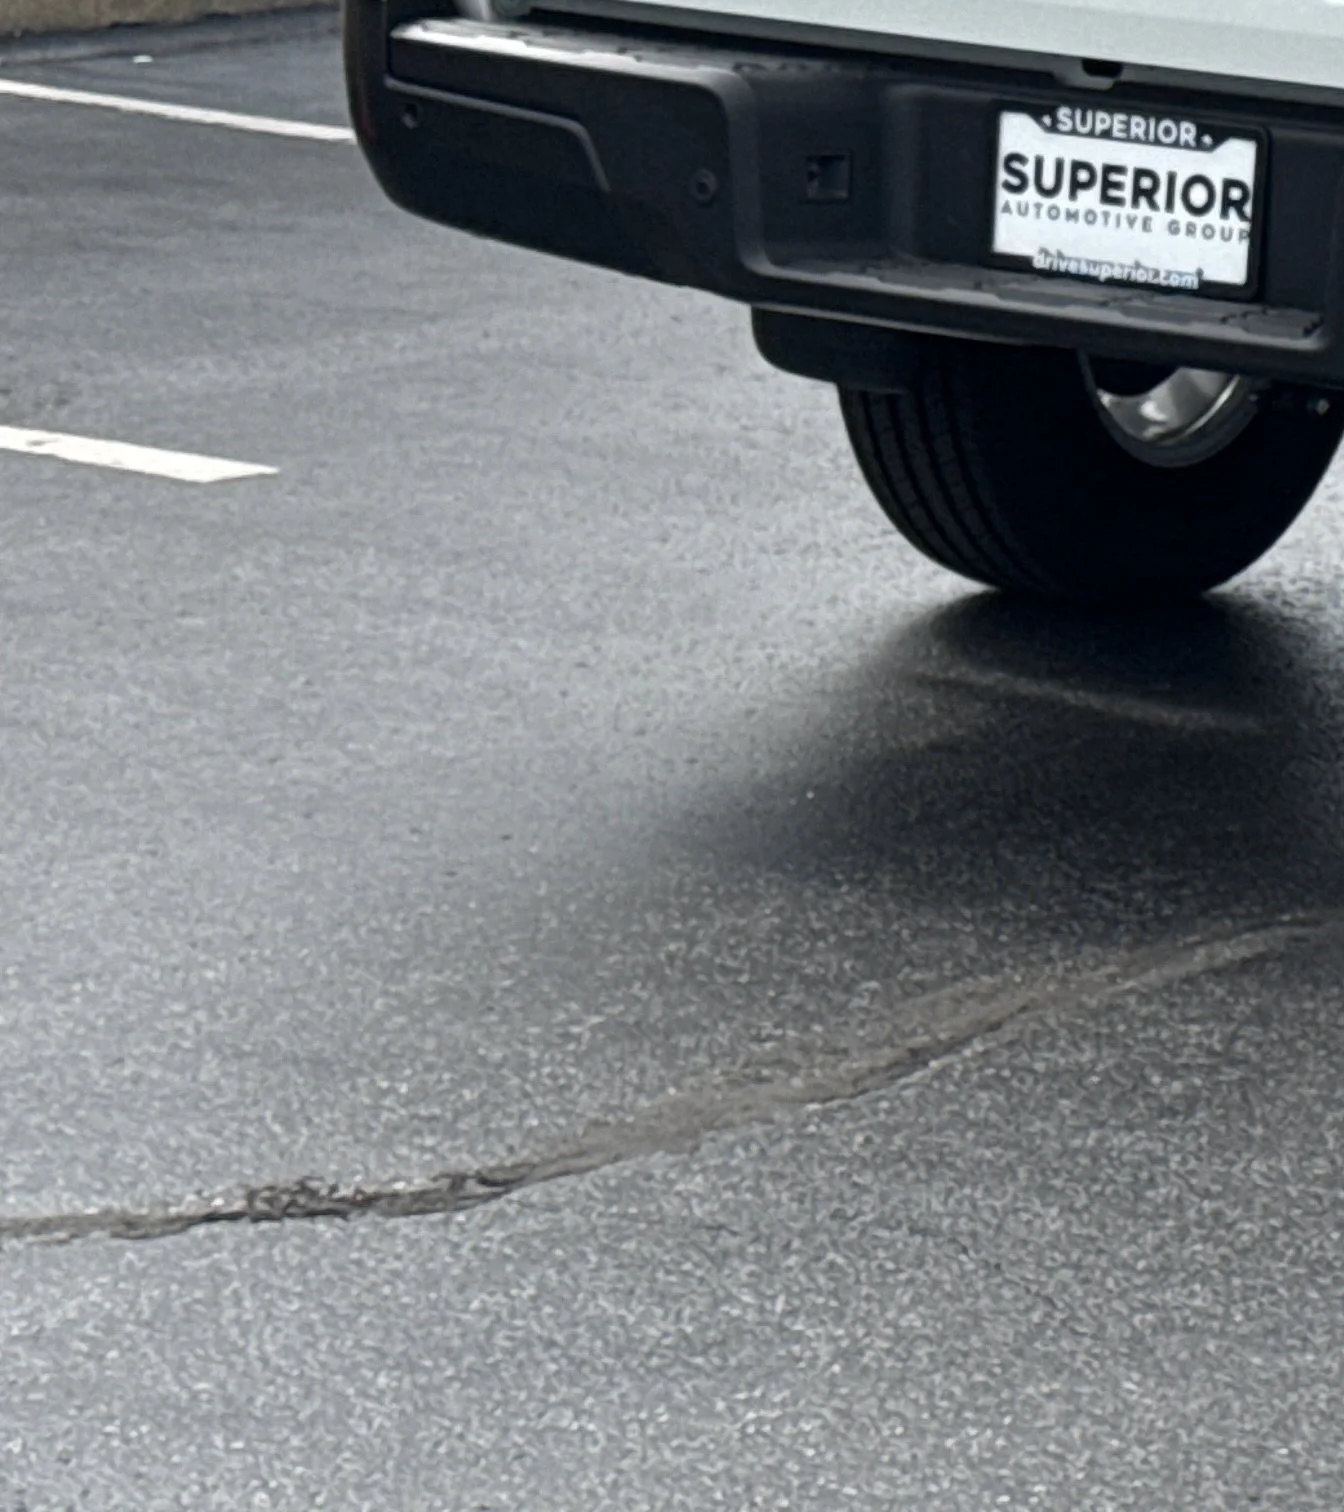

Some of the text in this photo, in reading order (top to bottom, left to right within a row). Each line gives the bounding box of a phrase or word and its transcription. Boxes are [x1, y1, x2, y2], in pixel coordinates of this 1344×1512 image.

[1056, 106, 1198, 148] SUPERIOR
[1001, 151, 1251, 222] SUPERIOR
[1000, 199, 1251, 245] AUTOMOTIVE GROUP
